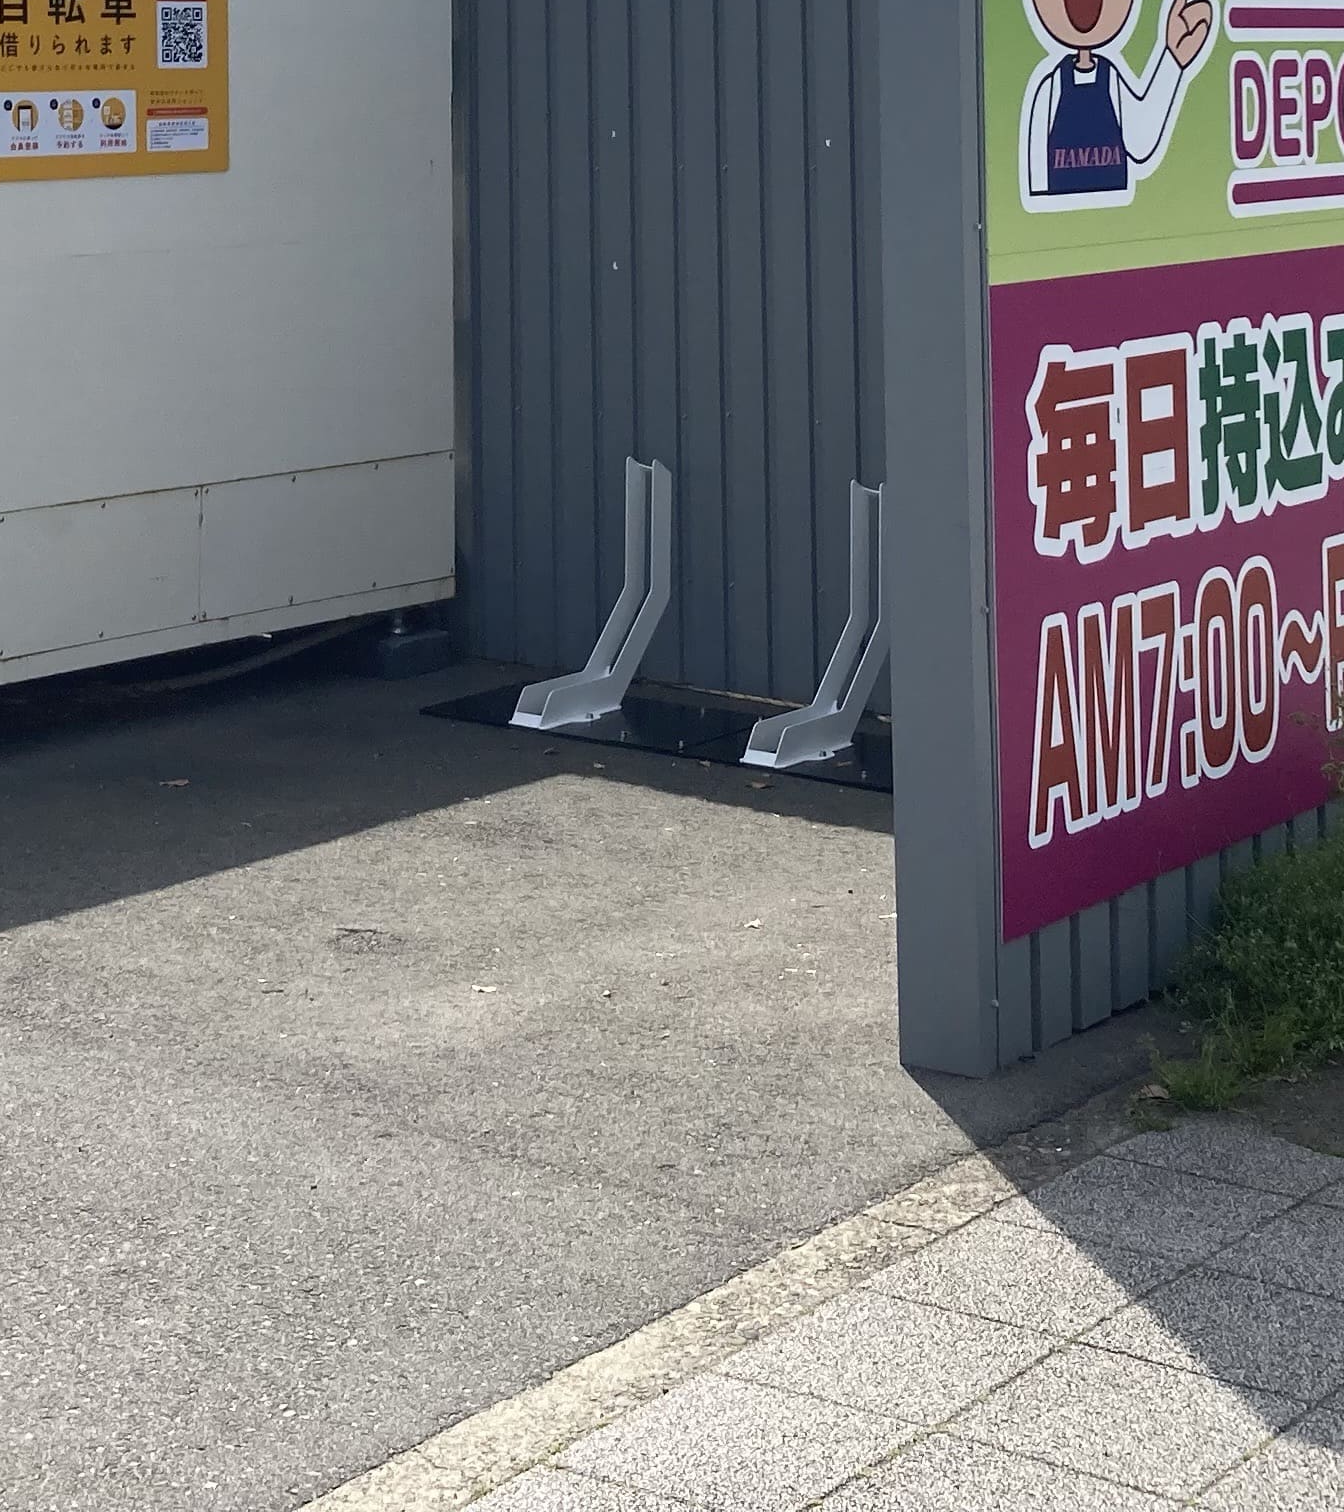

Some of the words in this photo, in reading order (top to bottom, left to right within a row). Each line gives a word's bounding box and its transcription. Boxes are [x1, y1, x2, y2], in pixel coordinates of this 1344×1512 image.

[0, 31, 137, 58] 借りられます
[1053, 145, 1122, 169] HAMADA
